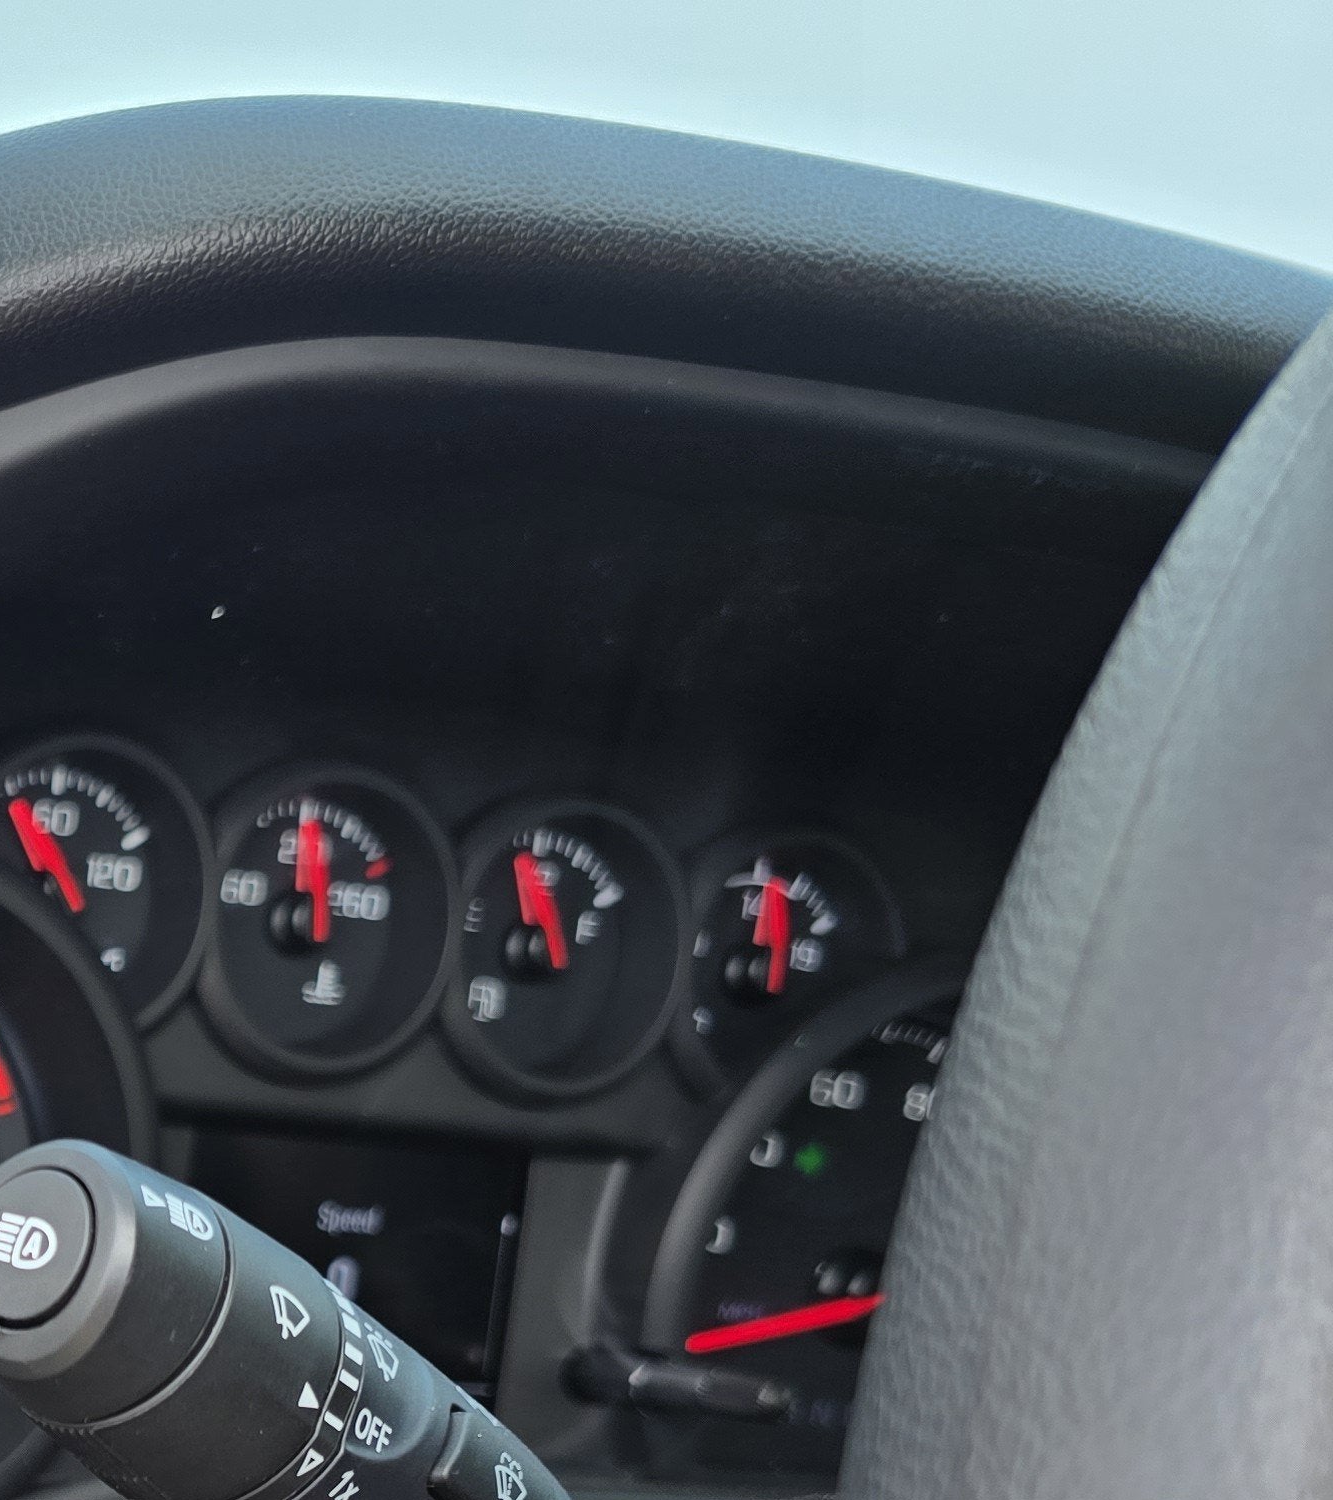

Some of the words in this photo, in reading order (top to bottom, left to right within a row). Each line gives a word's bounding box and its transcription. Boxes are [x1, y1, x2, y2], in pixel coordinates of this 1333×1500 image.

[87, 852, 144, 892] 120
[317, 1200, 386, 1236] Speed
[354, 1407, 393, 1454] OFF
